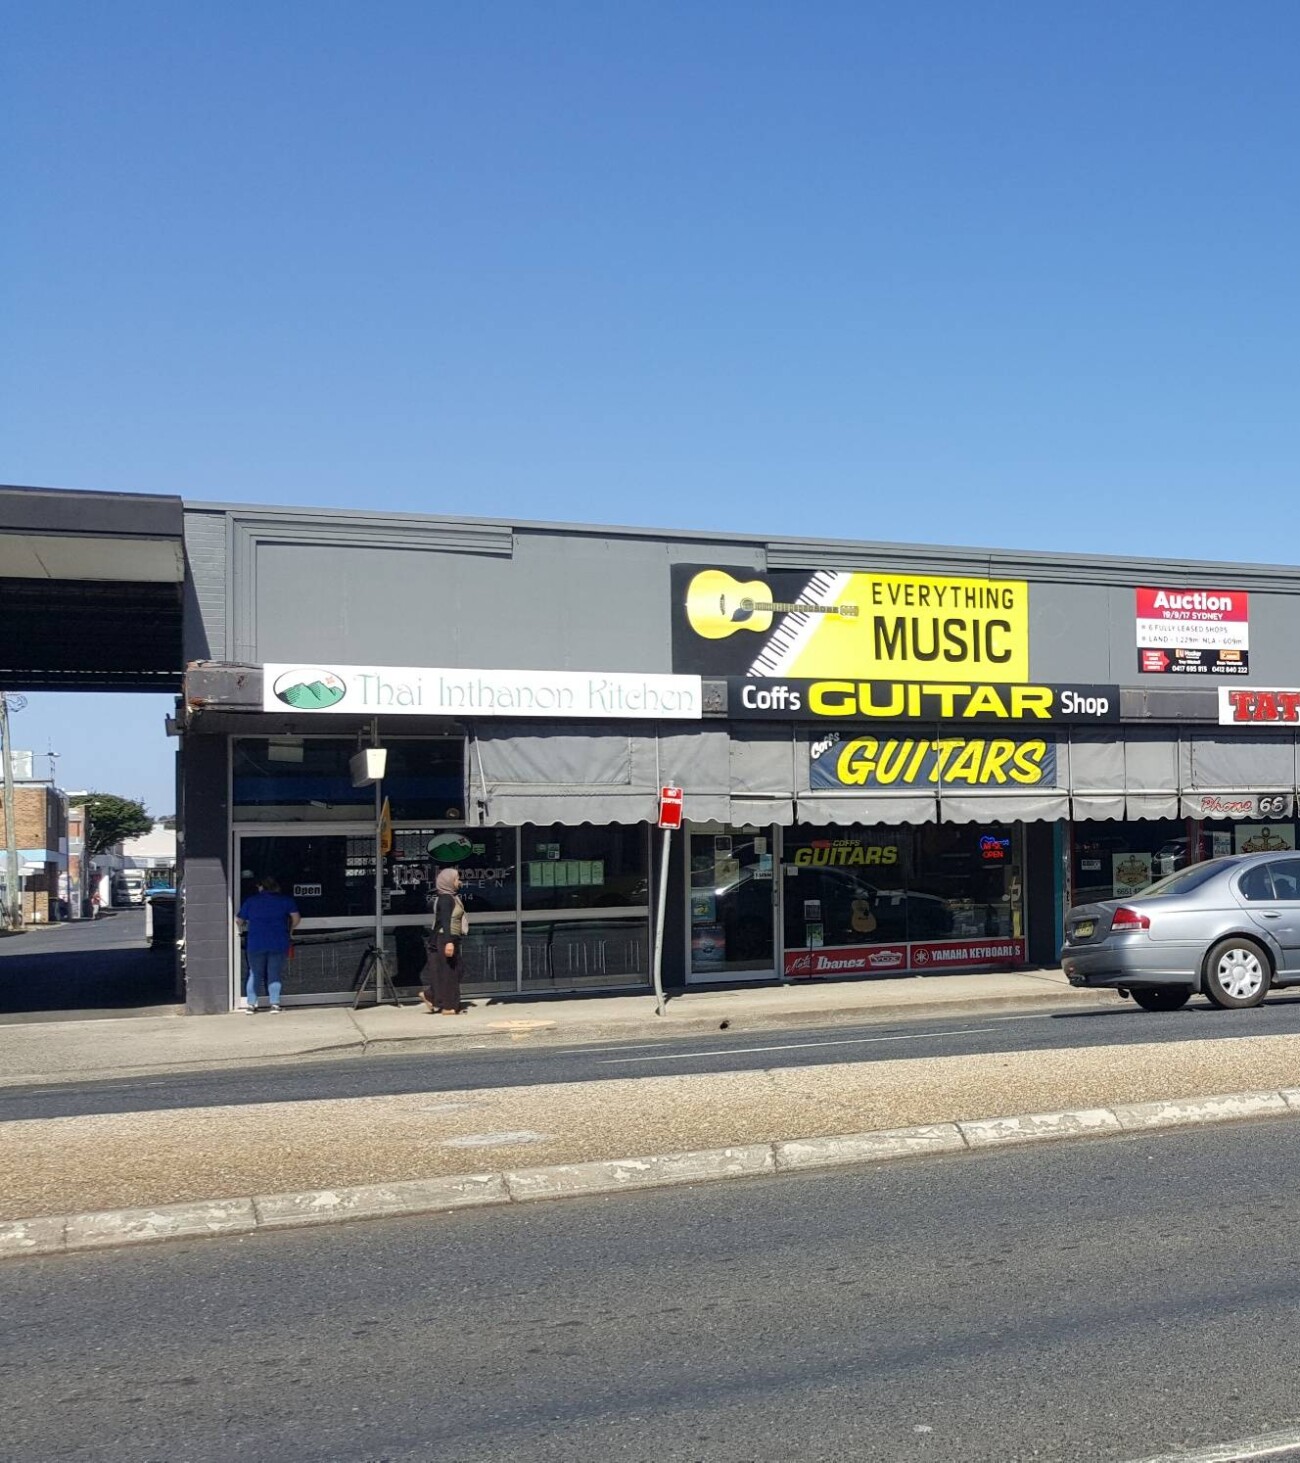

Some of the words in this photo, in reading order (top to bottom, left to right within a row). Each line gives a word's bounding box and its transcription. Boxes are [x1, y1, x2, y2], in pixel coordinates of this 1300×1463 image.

[872, 581, 1014, 610] EVERYTHING
[1153, 591, 1232, 611] Auction
[1192, 612, 1224, 621] SYDNEY
[1177, 625, 1203, 633] LEASED
[874, 615, 1012, 664] MUSIC
[353, 672, 422, 707] Thai
[439, 676, 573, 709] Inthanon
[588, 679, 694, 713] Kitchen
[742, 684, 801, 711] Coffs
[809, 681, 1053, 718] GUITAR
[1061, 690, 1109, 716] Shop
[811, 732, 840, 759] Coffs
[837, 735, 1047, 785] GUITARS
[1200, 796, 1253, 812] Phone
[1259, 797, 1284, 812] 66
[832, 839, 861, 847] COFFS
[794, 846, 898, 867] GUITARS
[294, 885, 321, 895] Open
[816, 955, 865, 971] Ibanez
[931, 948, 968, 961] YAMAHA
